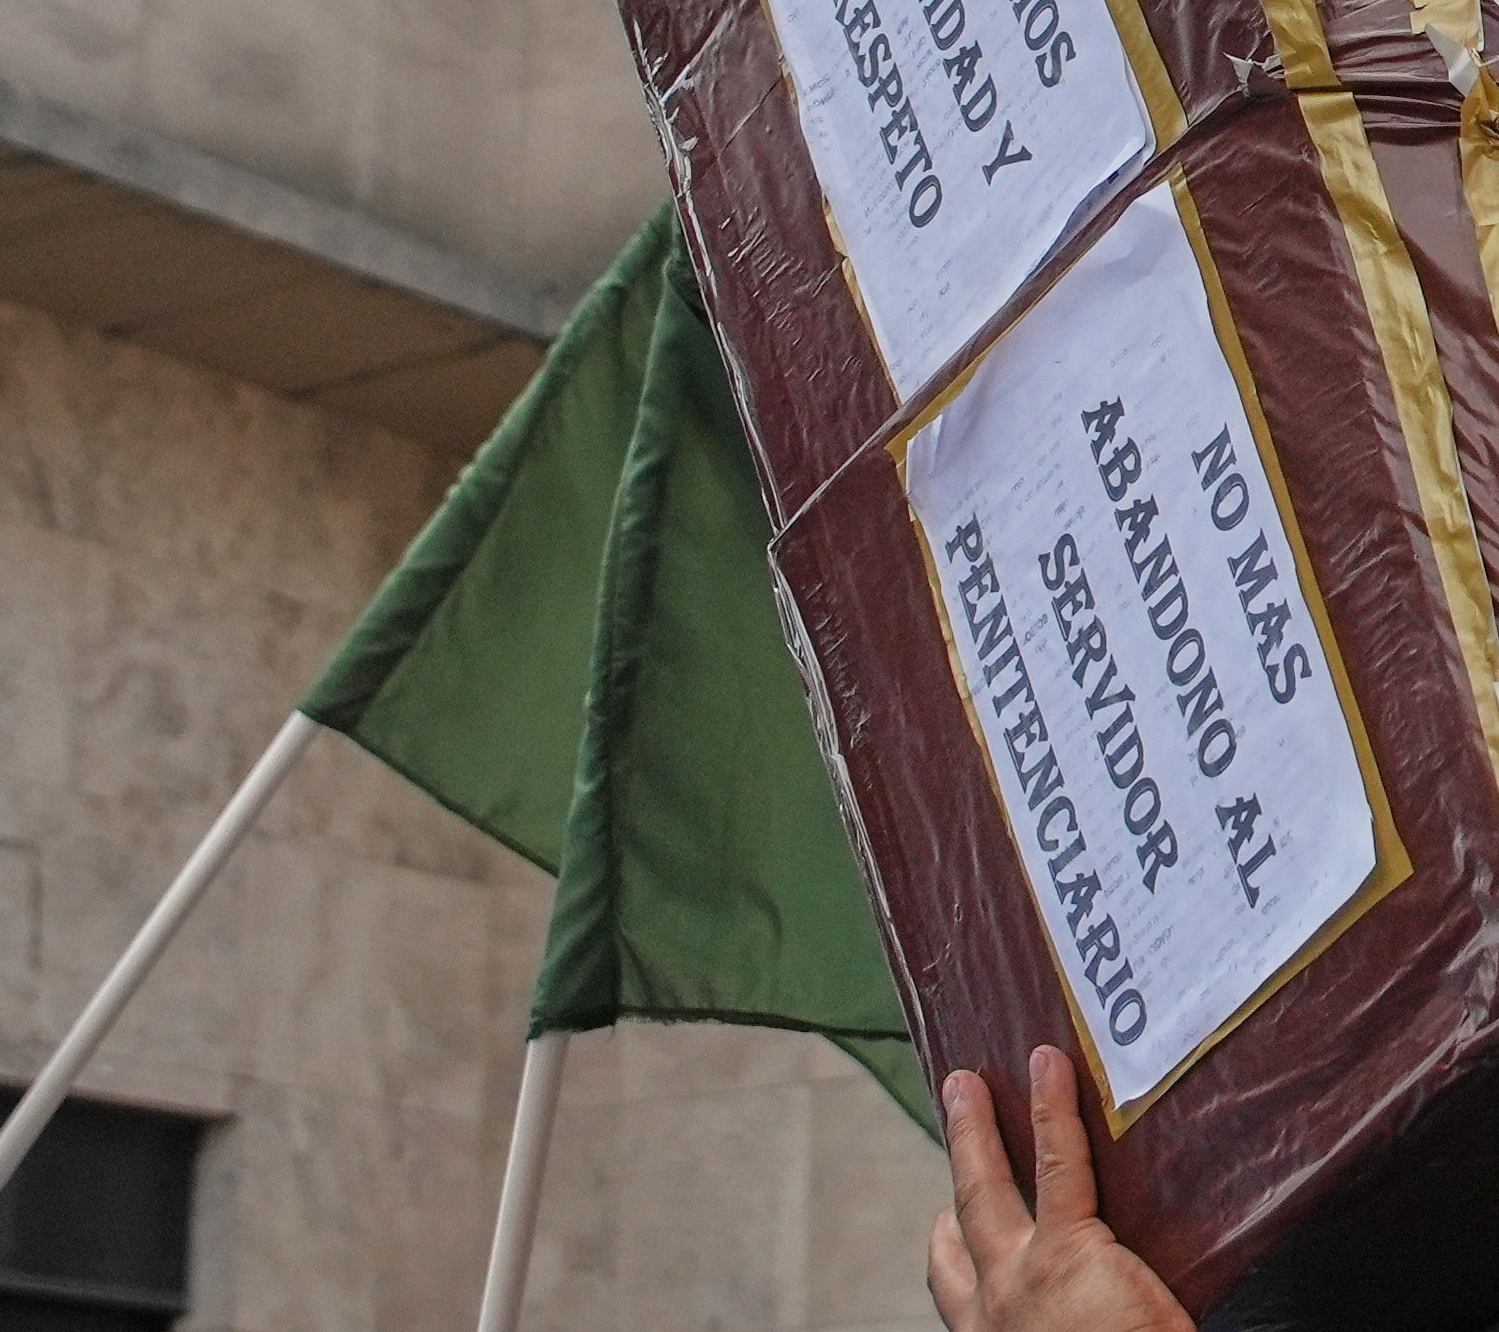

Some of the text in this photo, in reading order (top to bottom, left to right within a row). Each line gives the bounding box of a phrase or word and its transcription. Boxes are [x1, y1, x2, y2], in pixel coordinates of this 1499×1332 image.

[981, 123, 1033, 187] Y
[1037, 533, 1179, 895] SERVIDOR
[1080, 395, 1277, 909] ABANDONO AL
[1190, 422, 1313, 705] NO MAS
[944, 512, 1148, 1047] PENITENCIARIO
